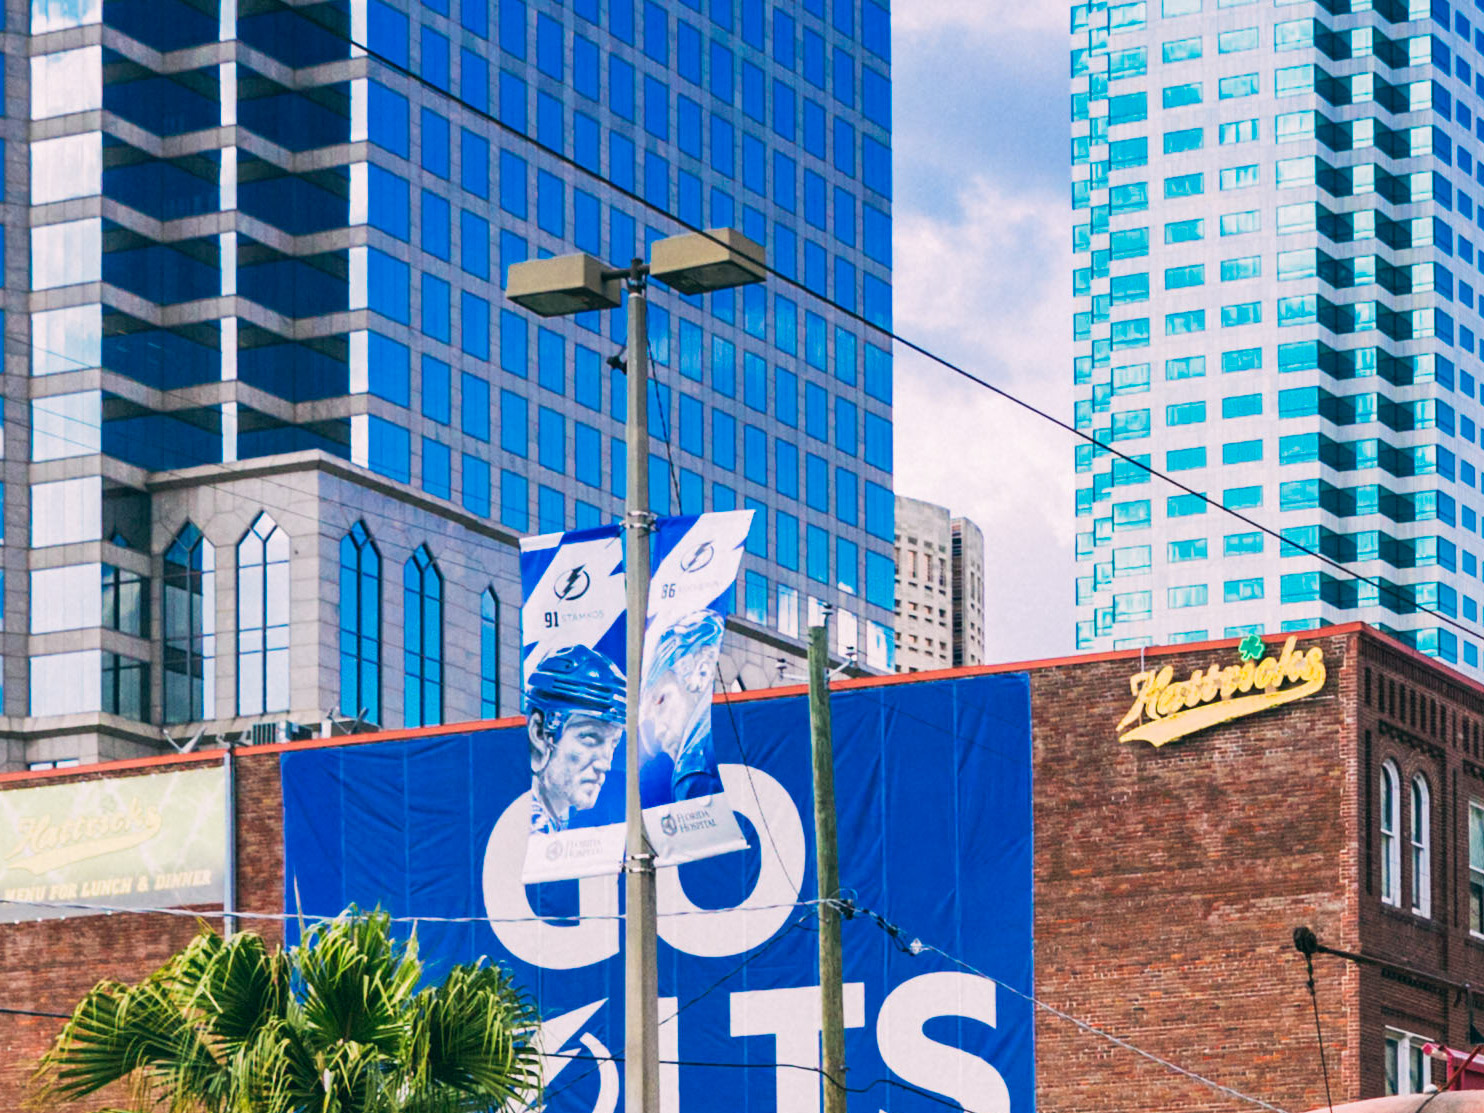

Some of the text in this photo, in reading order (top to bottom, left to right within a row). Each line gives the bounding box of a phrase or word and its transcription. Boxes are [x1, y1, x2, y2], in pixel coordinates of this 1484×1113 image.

[661, 584, 676, 600] 86
[544, 611, 559, 628] 91
[50, 882, 77, 900] FOR
[81, 876, 133, 897] LUNCH
[135, 876, 149, 893] &
[153, 870, 212, 891] DINNER
